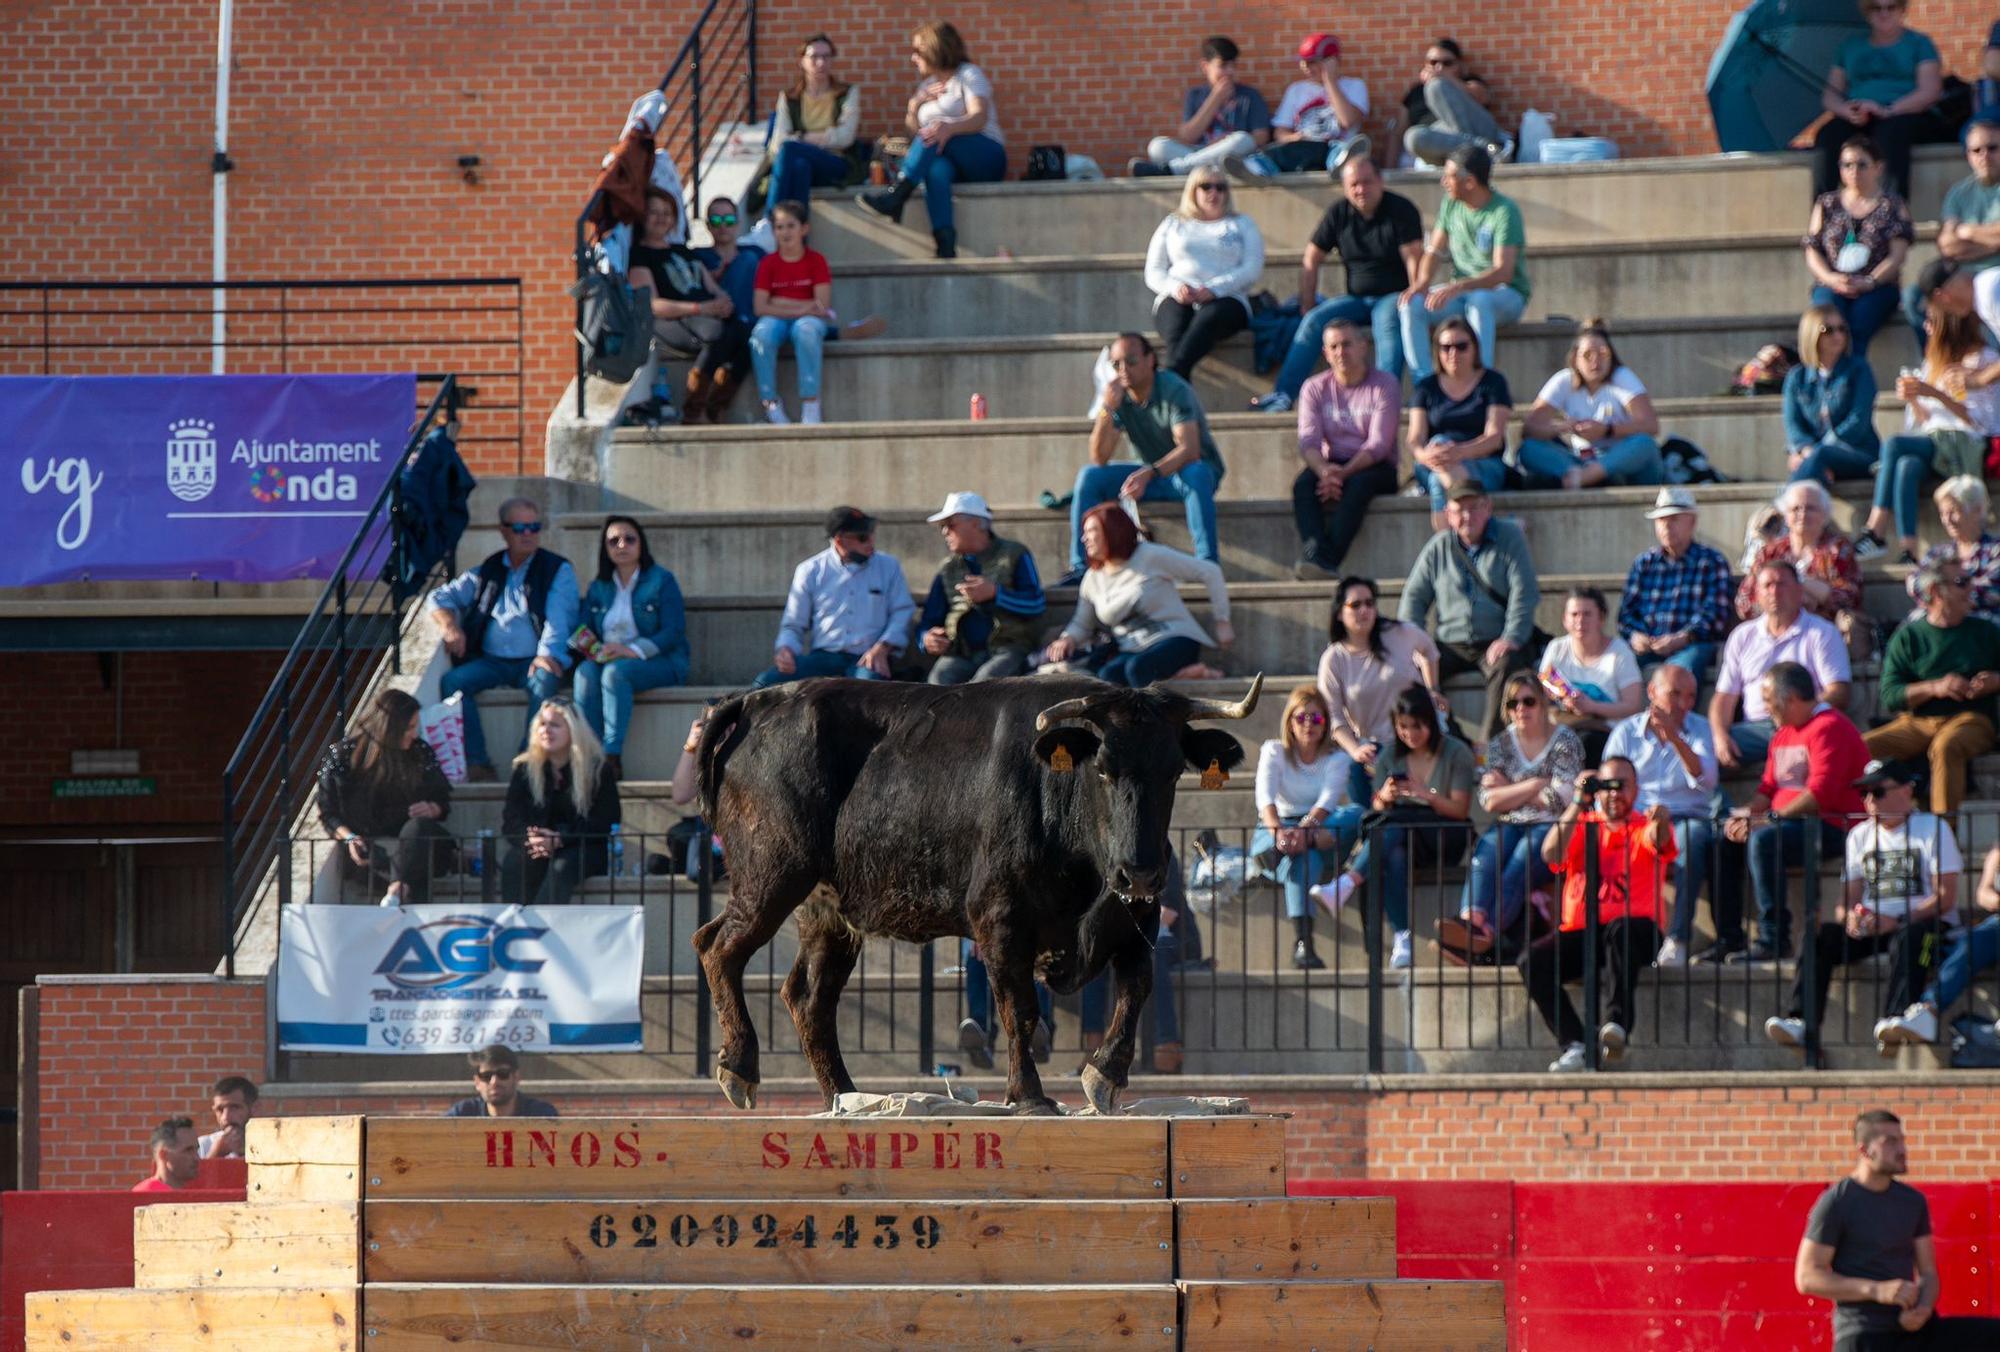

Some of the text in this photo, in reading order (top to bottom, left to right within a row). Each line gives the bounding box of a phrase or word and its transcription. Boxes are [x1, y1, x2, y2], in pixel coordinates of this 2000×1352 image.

[230, 438, 382, 468] Ajuntament
[20, 456, 104, 550] vg
[249, 465, 358, 503] Onda
[371, 926, 551, 975] AGC
[402, 1025, 536, 1045] 639 361 563
[484, 1130, 1005, 1170] HNOS. SAMPER
[589, 1213, 942, 1250] 620924439
